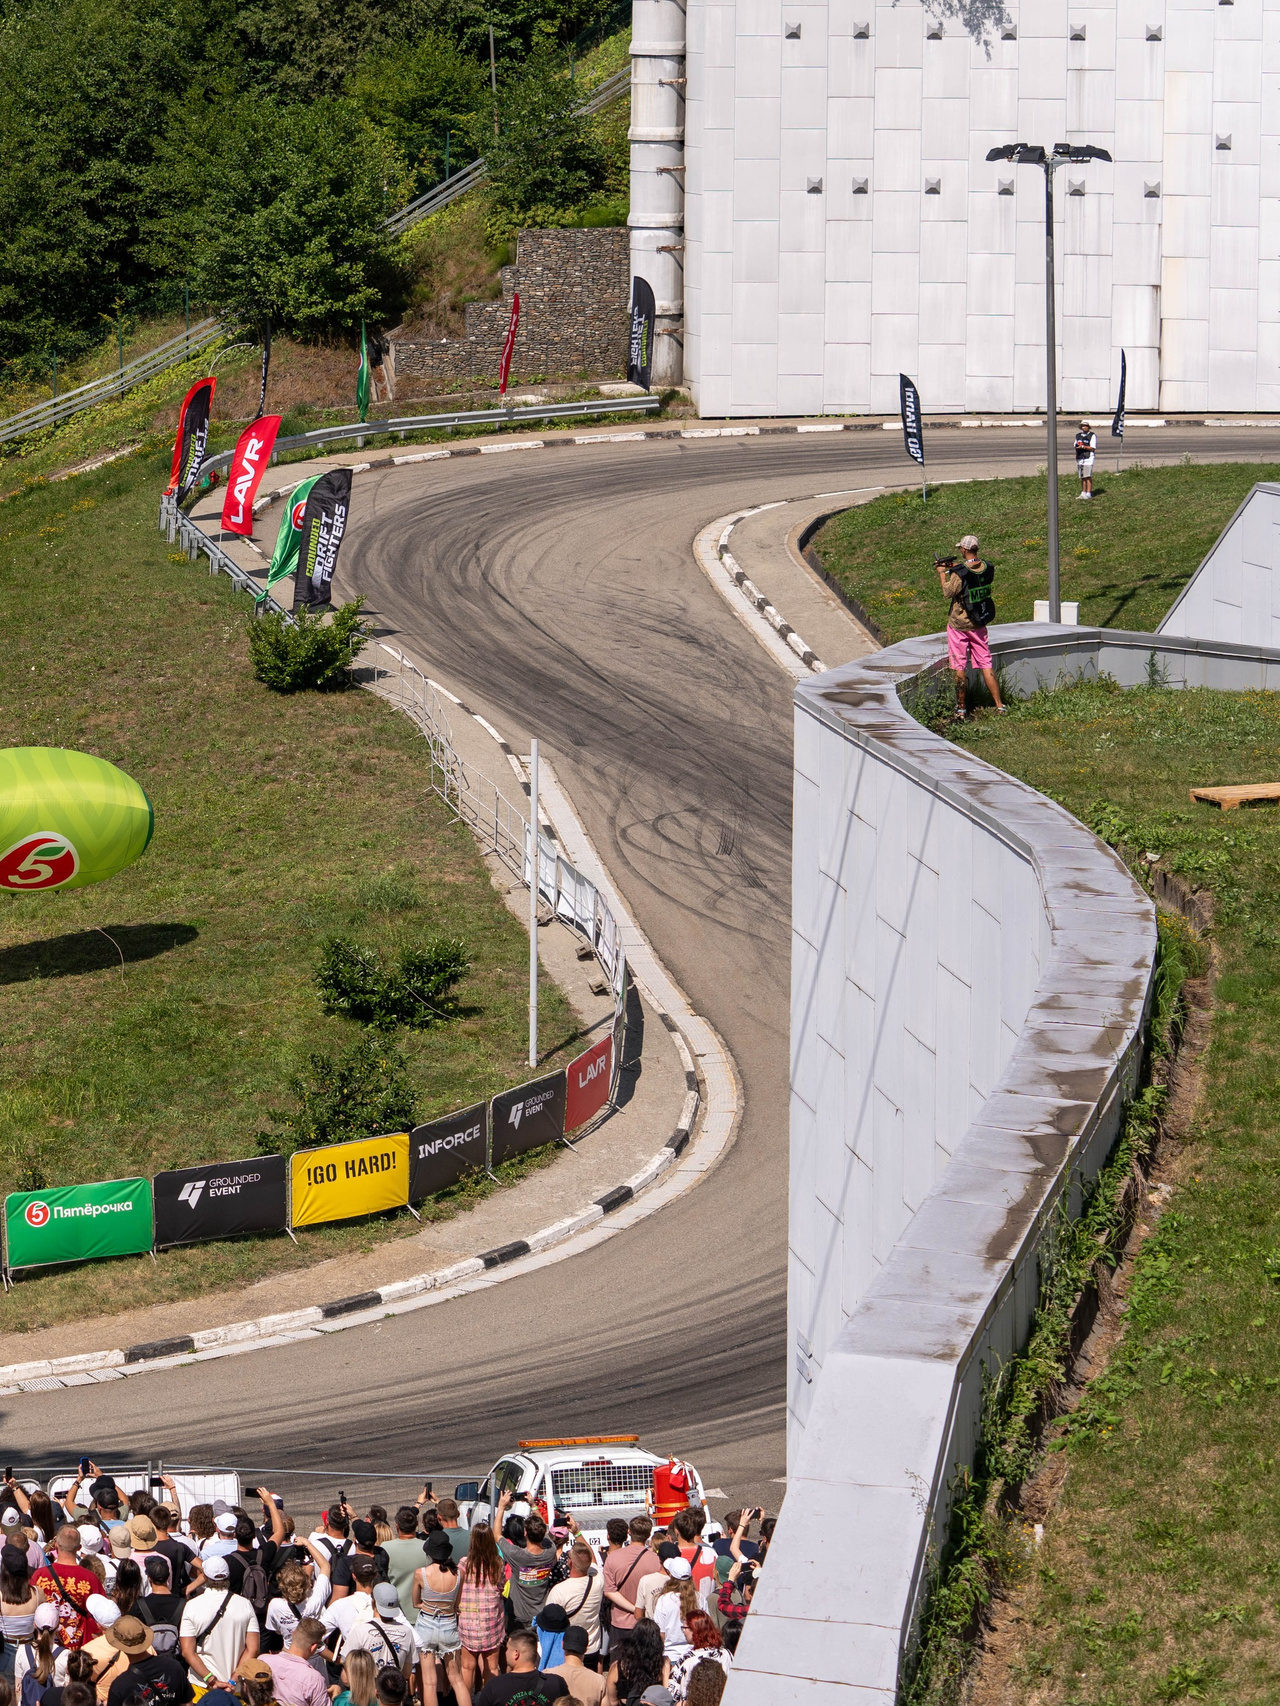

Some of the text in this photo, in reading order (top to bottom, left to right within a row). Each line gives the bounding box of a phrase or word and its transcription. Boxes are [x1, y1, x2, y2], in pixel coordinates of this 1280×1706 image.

[230, 437, 264, 524] LAVR
[306, 517, 321, 578] GROUNDED
[313, 511, 333, 576] DRIFT
[322, 503, 346, 582] FIGHTERS
[578, 1056, 607, 1089] LAVR
[525, 1090, 554, 1109] GROUNDED
[525, 1103, 543, 1118] EVENT
[418, 1124, 481, 1159] INFORCE
[209, 1173, 261, 1188] GROUNDED
[307, 1151, 397, 1186] !GO HARD!
[209, 1185, 241, 1197] EVENT
[53, 1201, 133, 1221] Пятёрочка
